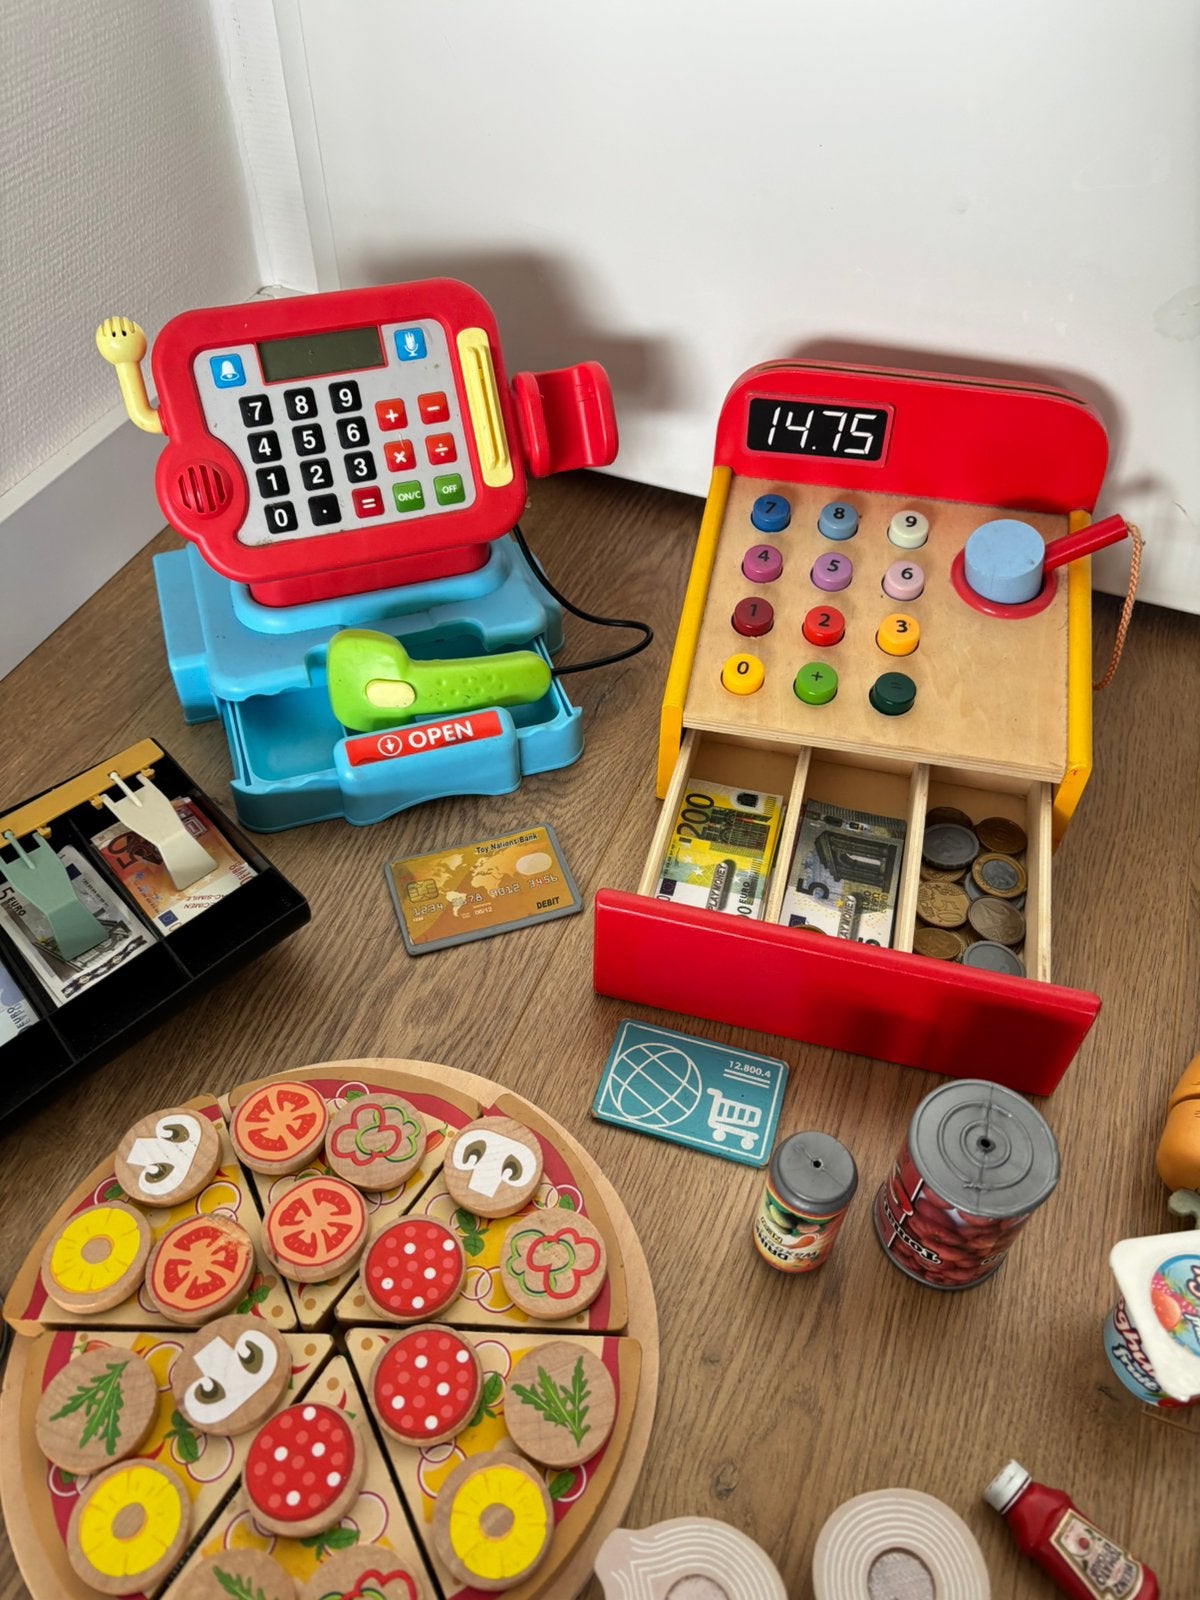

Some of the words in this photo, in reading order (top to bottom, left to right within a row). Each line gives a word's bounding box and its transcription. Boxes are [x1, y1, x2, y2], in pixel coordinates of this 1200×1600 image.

[249, 401, 263, 421] 7
[295, 395, 309, 415] 8
[338, 388, 353, 408] 9
[258, 437, 272, 457] 4
[303, 430, 316, 449] 5
[346, 423, 361, 443] 6
[767, 406, 878, 456] 14.75
[266, 472, 279, 492] 1
[311, 465, 325, 484] 2
[354, 457, 368, 477] 3
[397, 489, 422, 503] ON/C
[441, 484, 458, 496] OFF
[274, 508, 288, 528] 0
[765, 501, 777, 514] 7
[833, 507, 846, 520] 8
[905, 515, 918, 528] 9
[757, 549, 771, 563] 4
[827, 559, 841, 573] 5
[901, 567, 914, 580] 6
[749, 603, 759, 617] 1
[817, 613, 831, 627] 2
[896, 620, 909, 633] 3
[736, 660, 750, 675] 0
[407, 719, 475, 749] OPEN
[676, 792, 715, 839] 200
[475, 844, 489, 855] Toy
[491, 838, 518, 852] Nations
[519, 832, 538, 845] Bank
[738, 881, 750, 904] EURO
[796, 878, 830, 901] 5
[8, 897, 27, 917] EURO
[536, 896, 560, 910] DEBIT
[7, 1007, 25, 1029] EURO
[728, 1059, 772, 1078] 12.800.4
